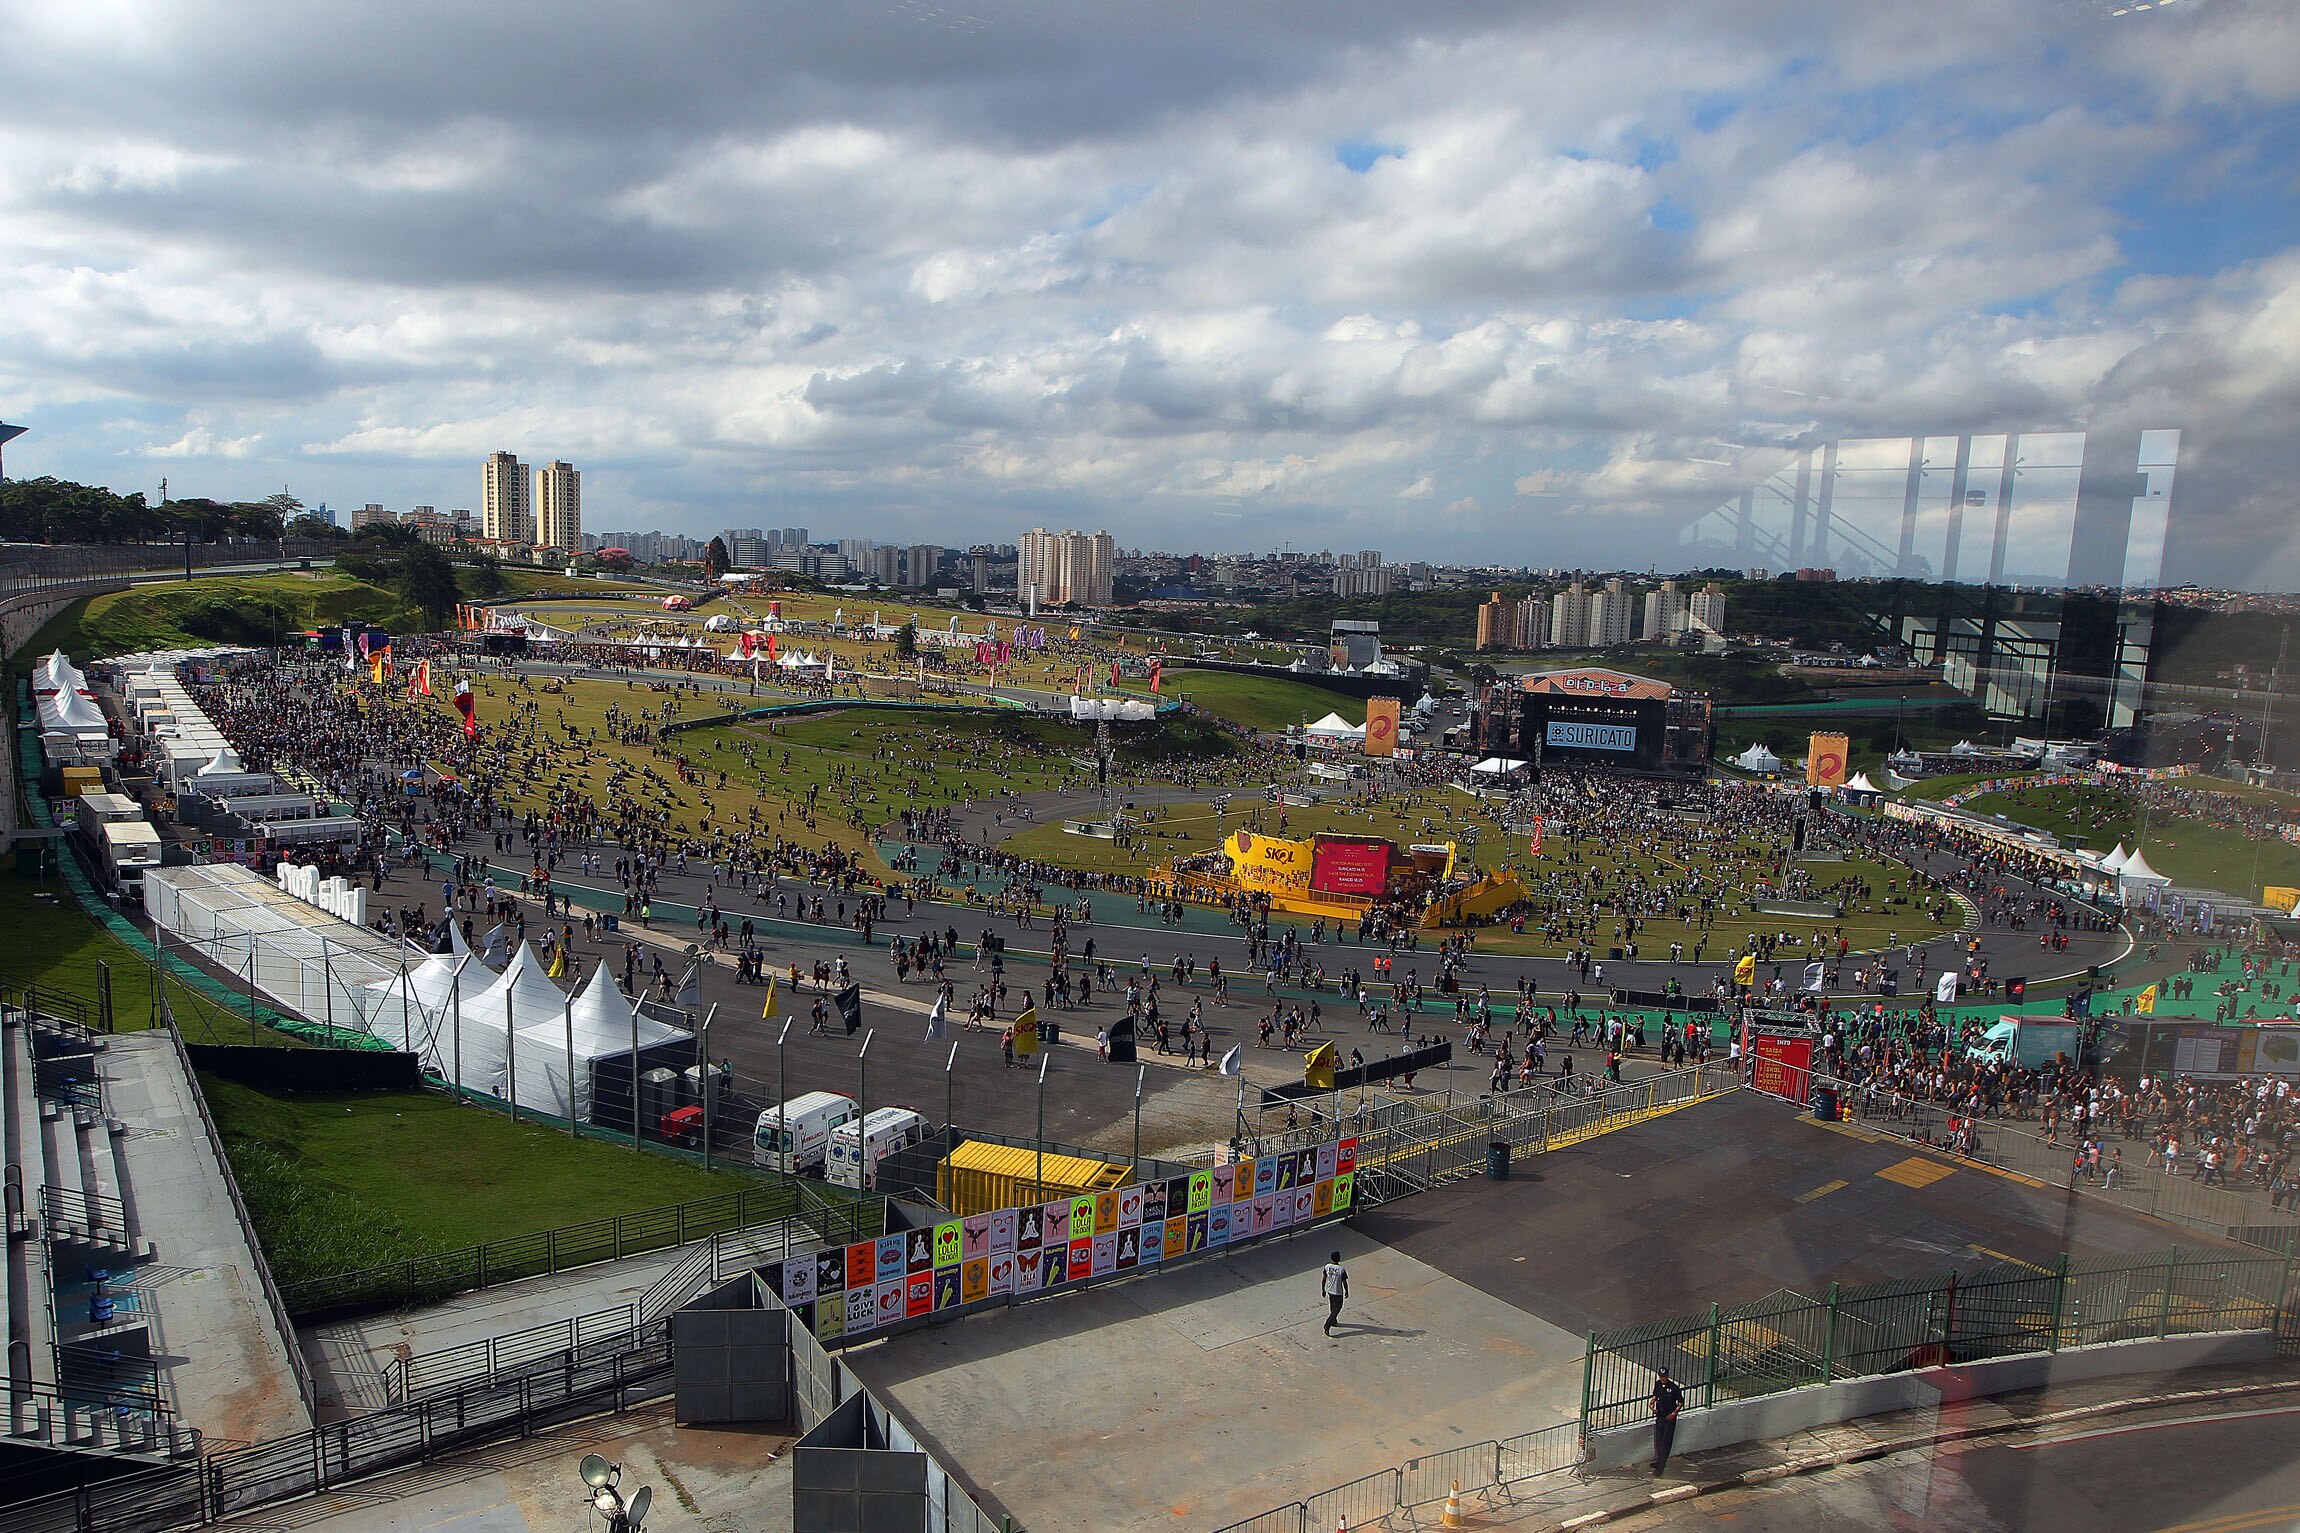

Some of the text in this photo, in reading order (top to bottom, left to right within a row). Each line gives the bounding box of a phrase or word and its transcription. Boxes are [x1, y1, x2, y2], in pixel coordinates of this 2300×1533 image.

[1566, 726, 1632, 747] SURICATO
[1265, 847, 1295, 865] SKOL
[853, 1300, 874, 1312] GIVE
[847, 1310, 874, 1321] LUCK
